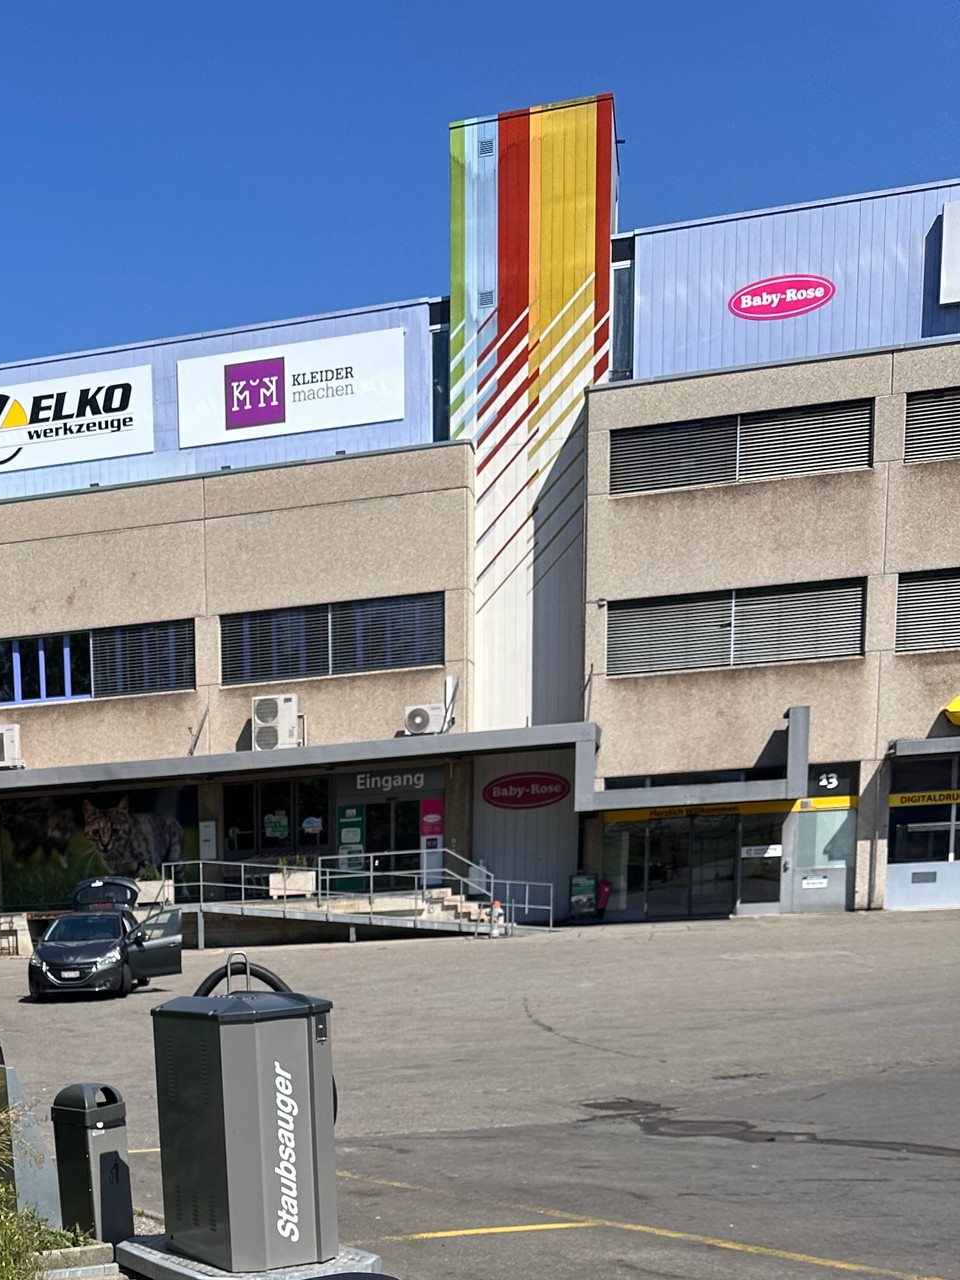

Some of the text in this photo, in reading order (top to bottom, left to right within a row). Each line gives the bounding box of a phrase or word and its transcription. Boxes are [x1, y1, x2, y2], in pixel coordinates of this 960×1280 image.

[740, 286, 825, 309] Baby-Rose
[292, 366, 355, 387] KLEIDER
[28, 382, 133, 425] ELKO
[292, 383, 355, 403] machen
[27, 416, 134, 440] werkzeuge
[356, 773, 425, 791] Eingang
[492, 783, 562, 799] Baby-Rose
[900, 792, 960, 805] DIGITALDRU
[274, 1060, 300, 1243] Staubsauger
